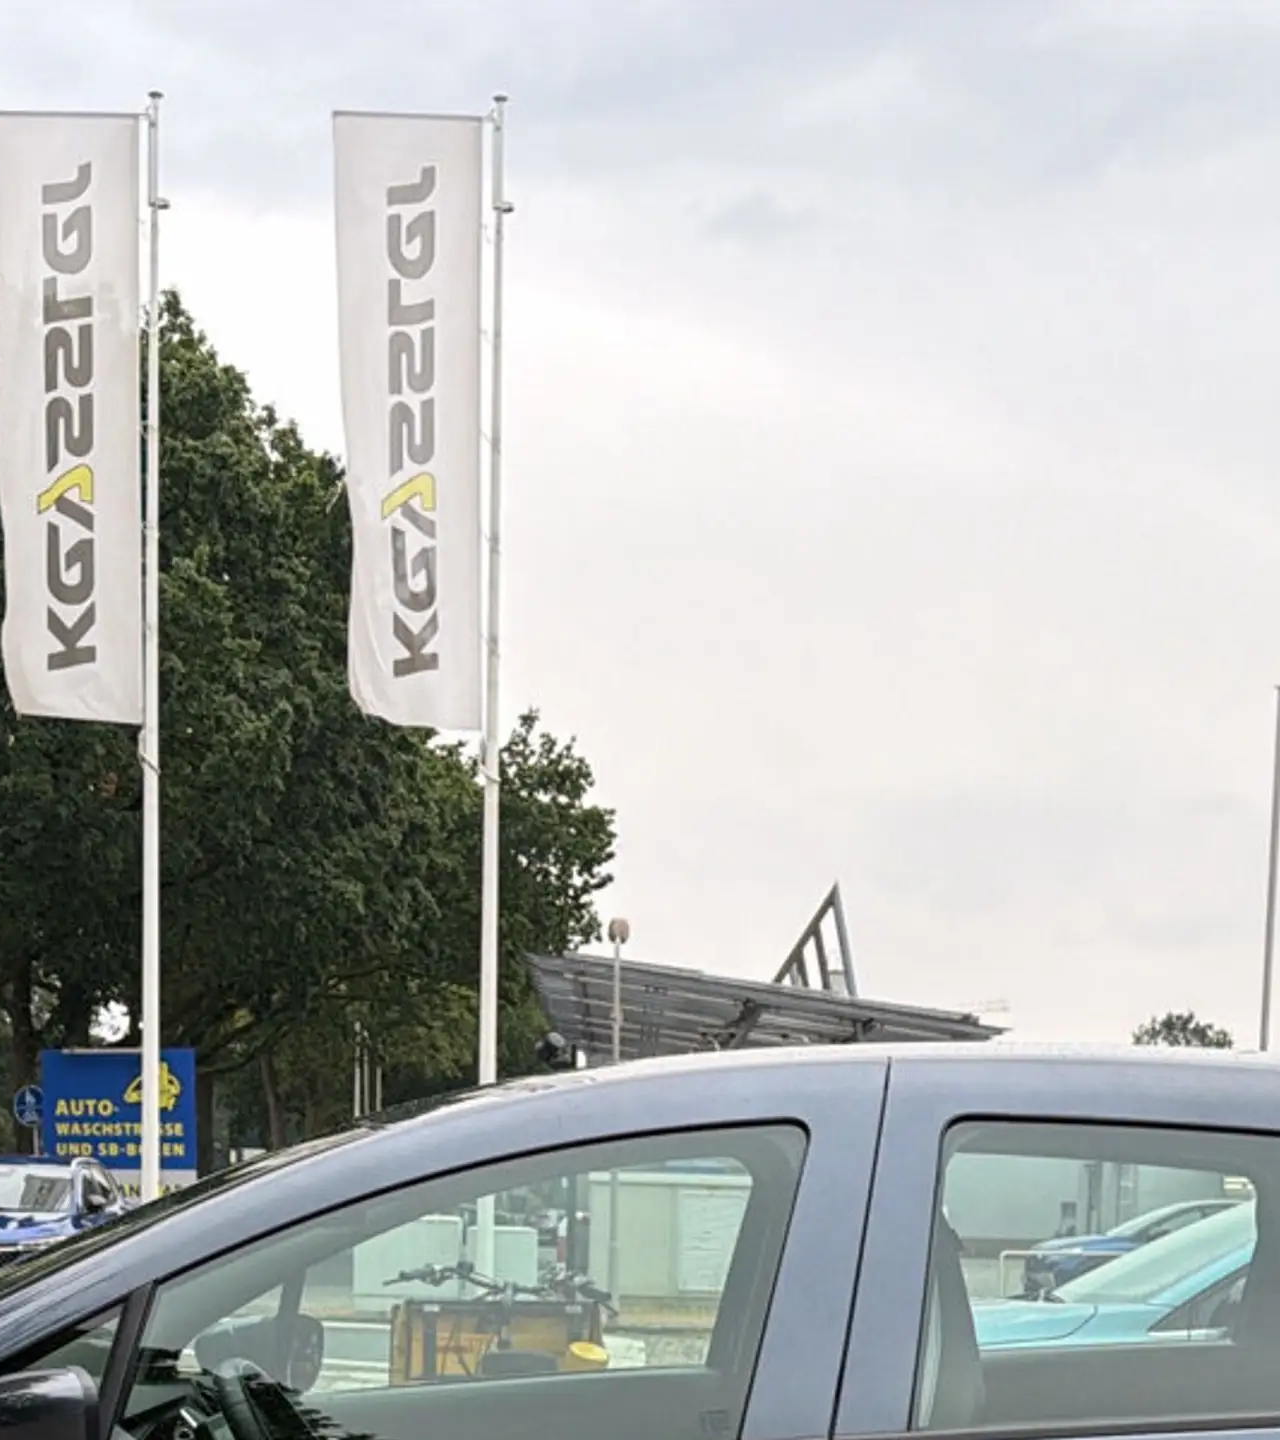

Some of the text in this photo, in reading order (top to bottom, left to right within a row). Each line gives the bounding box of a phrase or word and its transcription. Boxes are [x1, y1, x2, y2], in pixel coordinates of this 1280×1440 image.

[55, 1098, 120, 1116] AUTO-
[55, 1122, 185, 1137] WASCHSTRSSE
[56, 1142, 185, 1157] UND SB-BEN
